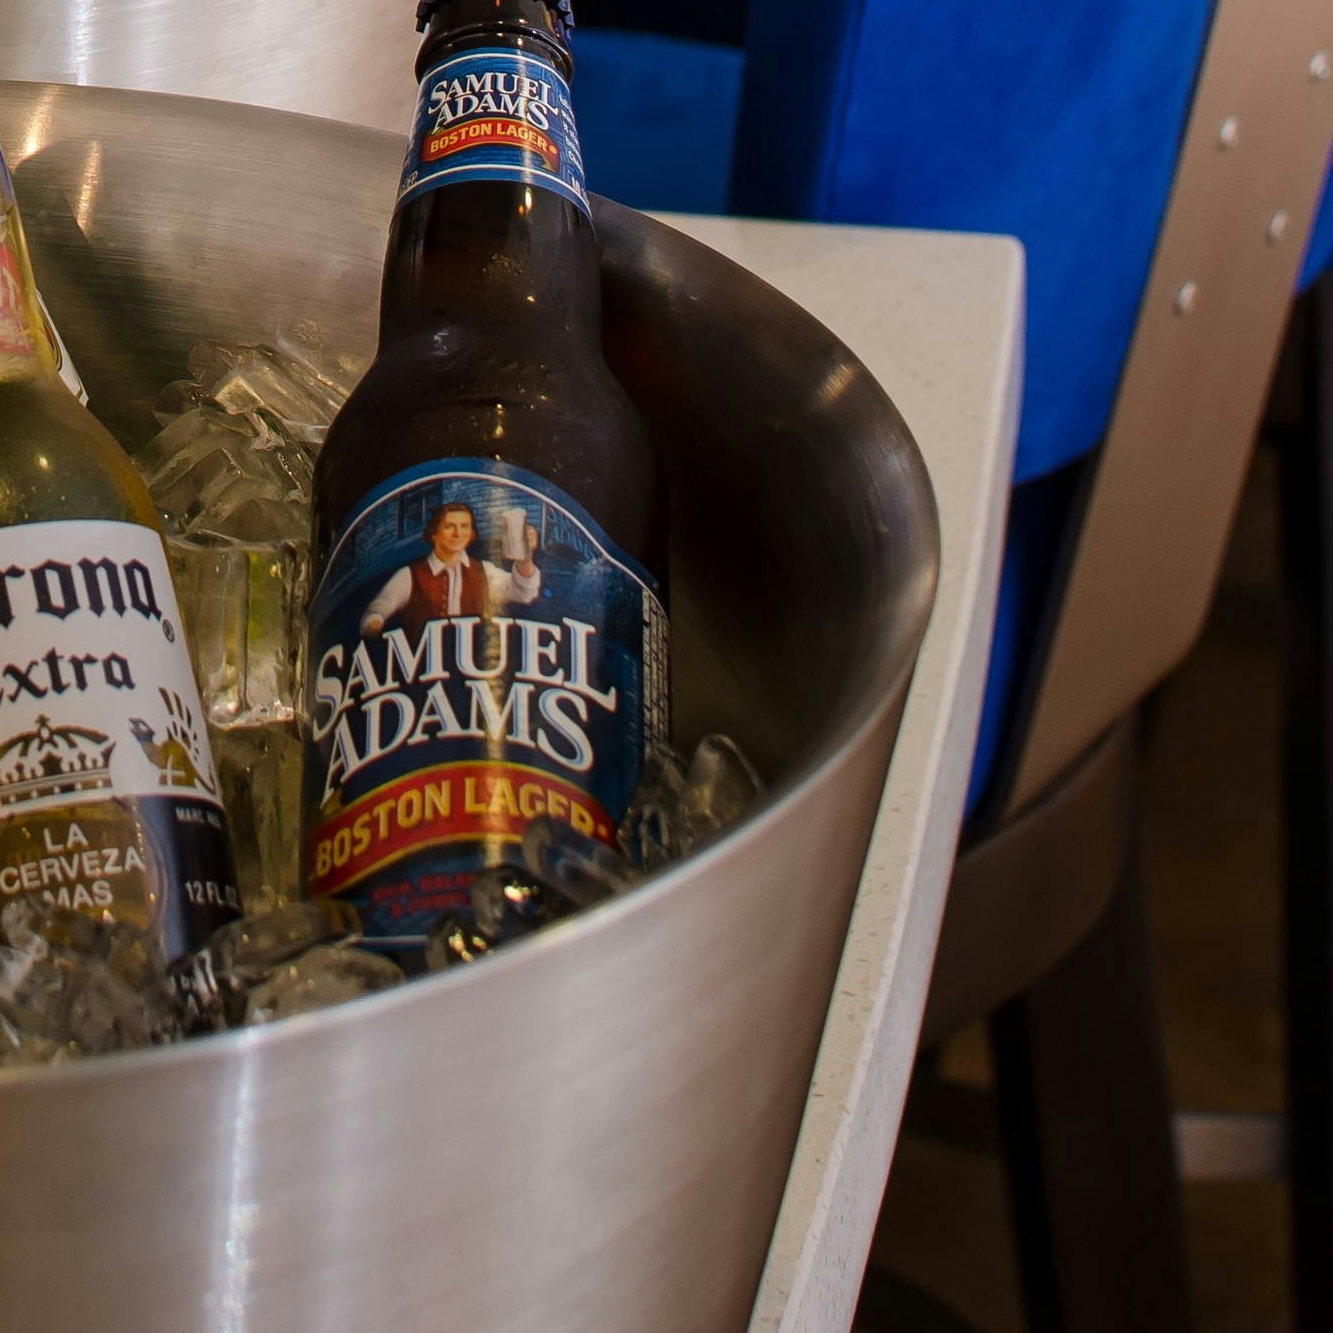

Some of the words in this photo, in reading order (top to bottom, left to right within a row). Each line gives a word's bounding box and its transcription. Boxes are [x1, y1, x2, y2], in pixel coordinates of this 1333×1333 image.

[427, 72, 559, 117] SAMUEL
[431, 94, 550, 135] ADAMS
[430, 122, 494, 154] BOSTON
[496, 122, 548, 152] LAGER
[313, 616, 618, 742] SAMUEL
[318, 679, 595, 809] ADAMS
[42, 822, 91, 854] LA
[315, 779, 452, 878] BOSTON
[184, 880, 206, 905] 12
